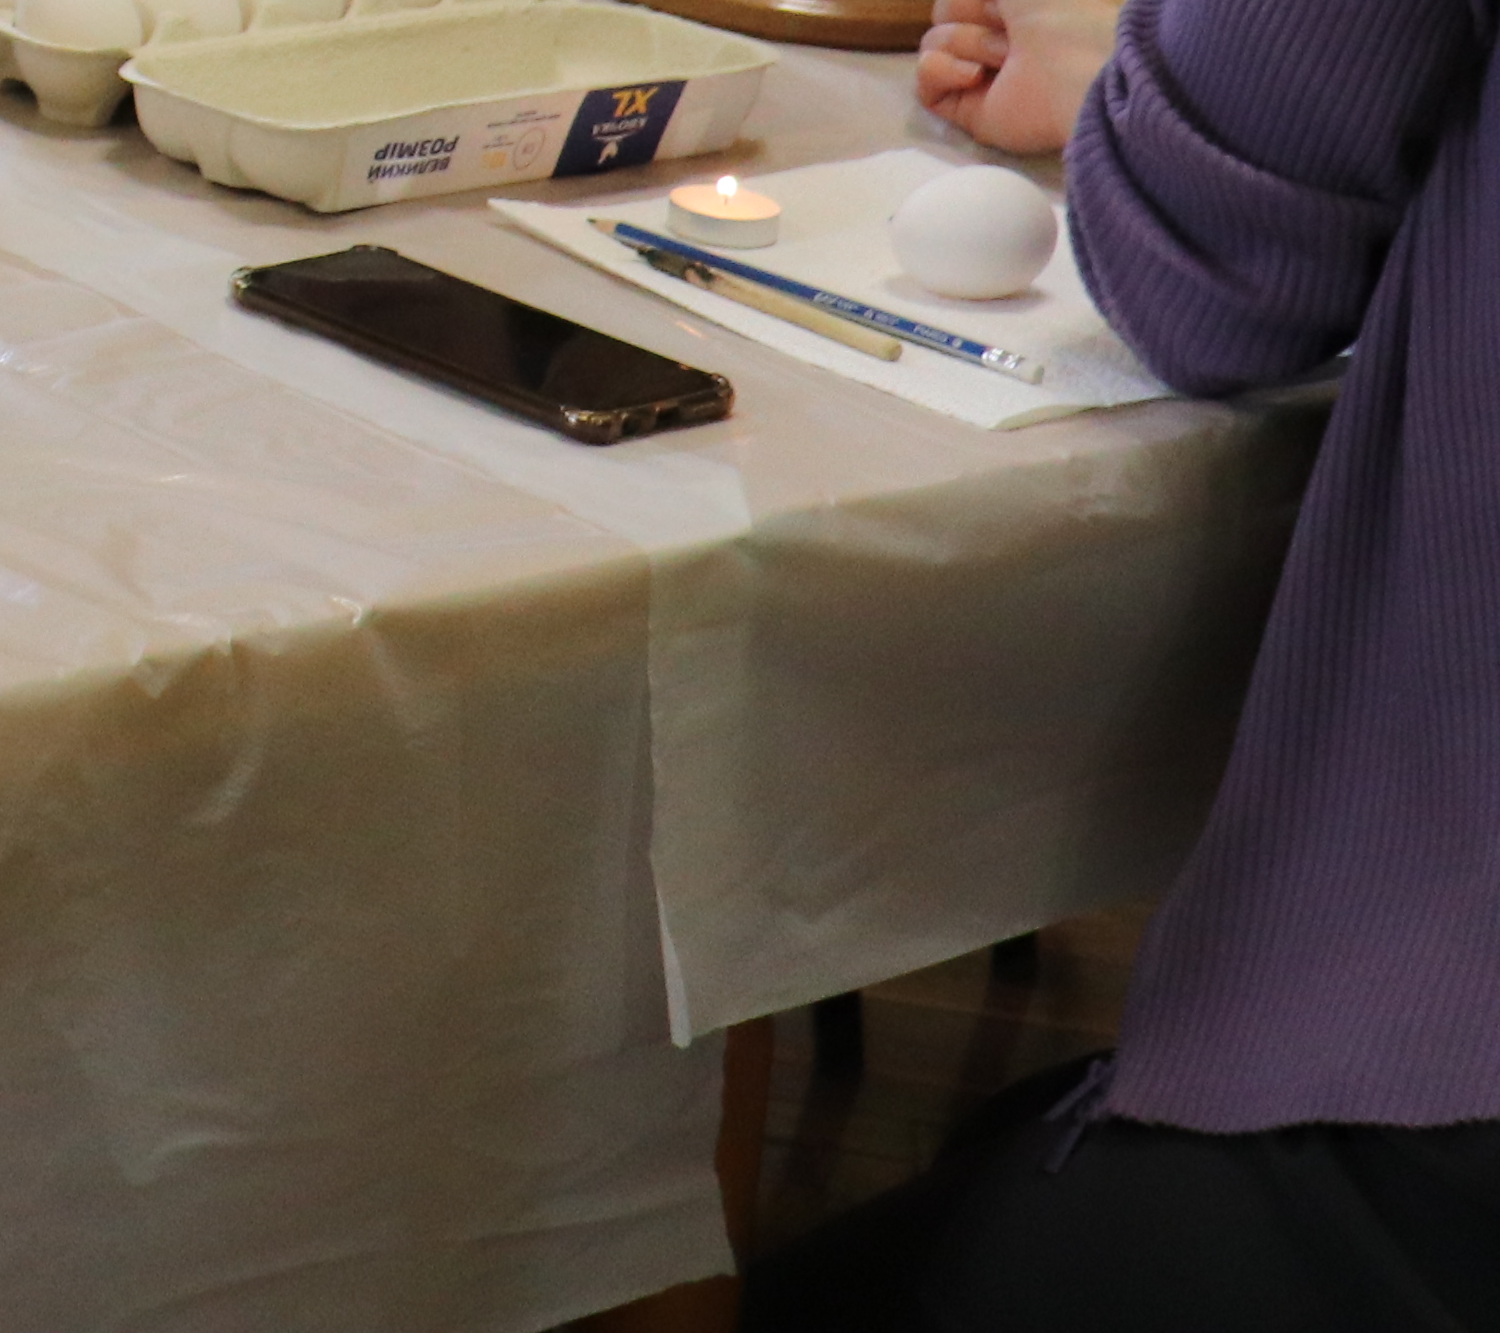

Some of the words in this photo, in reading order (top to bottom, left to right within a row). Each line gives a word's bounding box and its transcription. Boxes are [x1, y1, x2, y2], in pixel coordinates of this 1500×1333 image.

[612, 87, 659, 118] XL
[373, 135, 460, 162] РОЗМІР
[367, 157, 450, 183] ВЕЛИКИЙ
